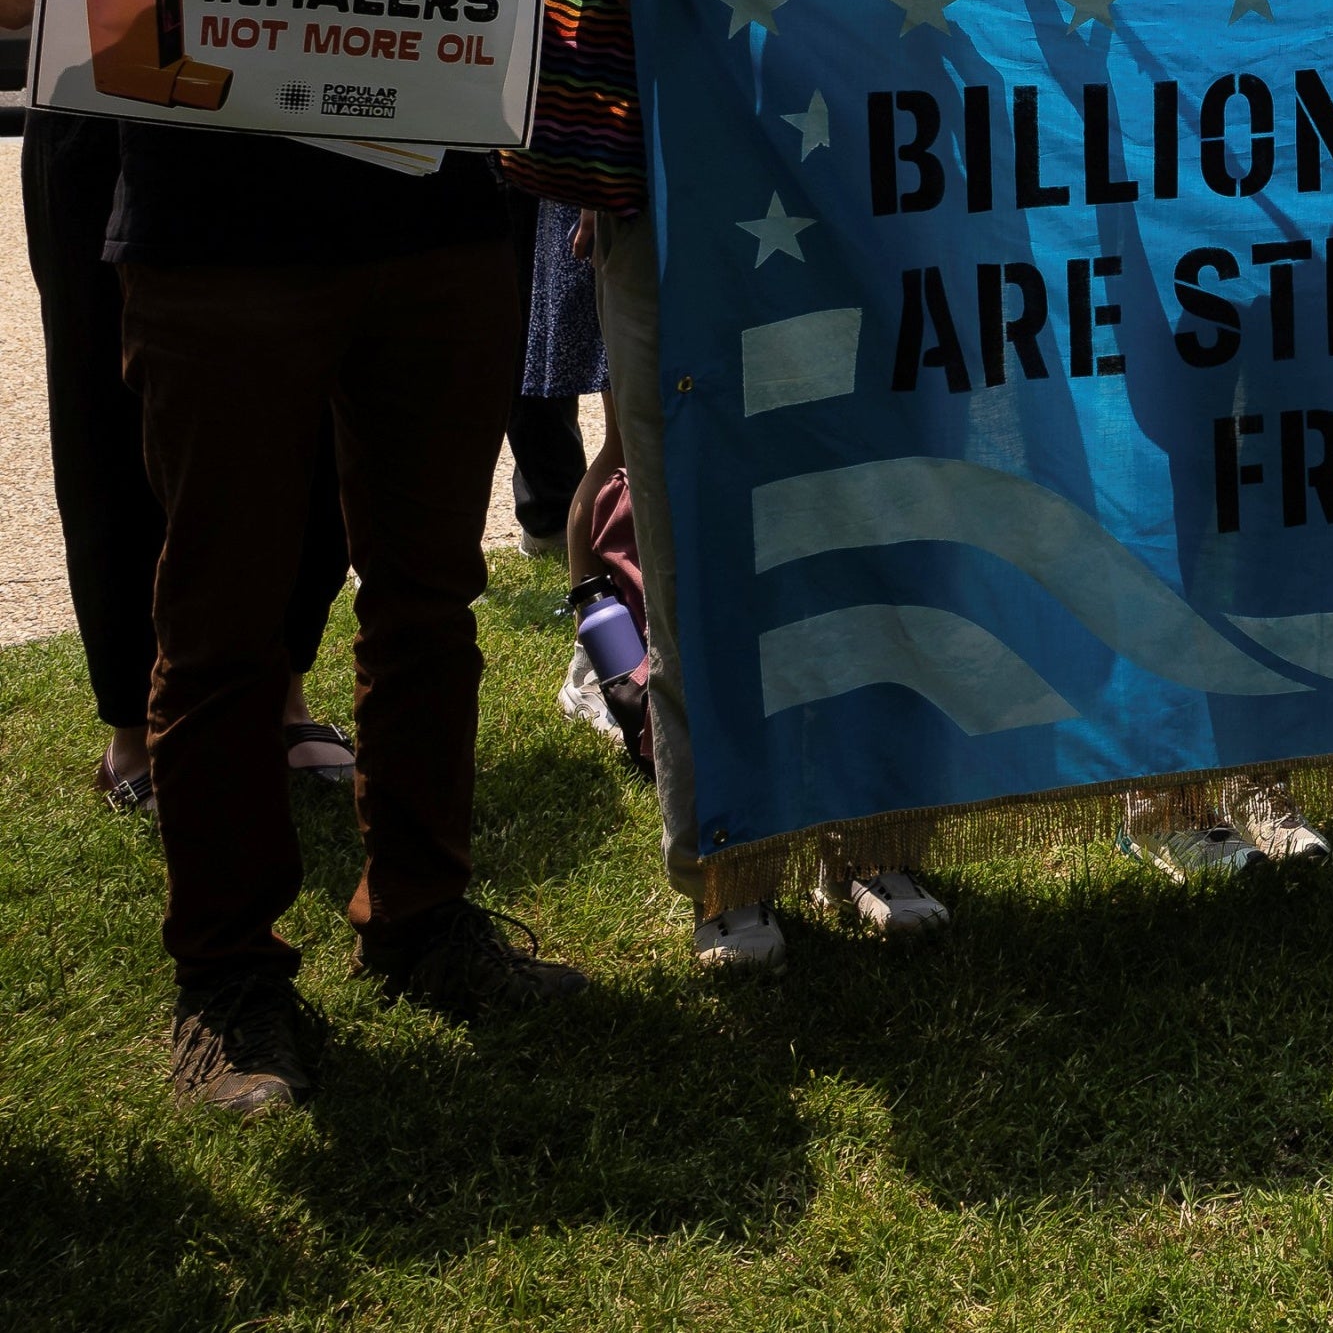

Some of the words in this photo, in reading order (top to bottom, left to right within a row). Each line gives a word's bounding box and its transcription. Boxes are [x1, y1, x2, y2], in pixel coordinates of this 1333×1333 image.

[200, 15, 289, 51] NOT
[303, 23, 423, 62] MORE
[437, 34, 495, 67] OIL
[324, 84, 397, 97] POPULAR
[323, 94, 397, 105] DEMOCRACY
[323, 104, 337, 113] IN
[340, 105, 393, 116] ACTION
[890, 255, 1128, 396] ARE
